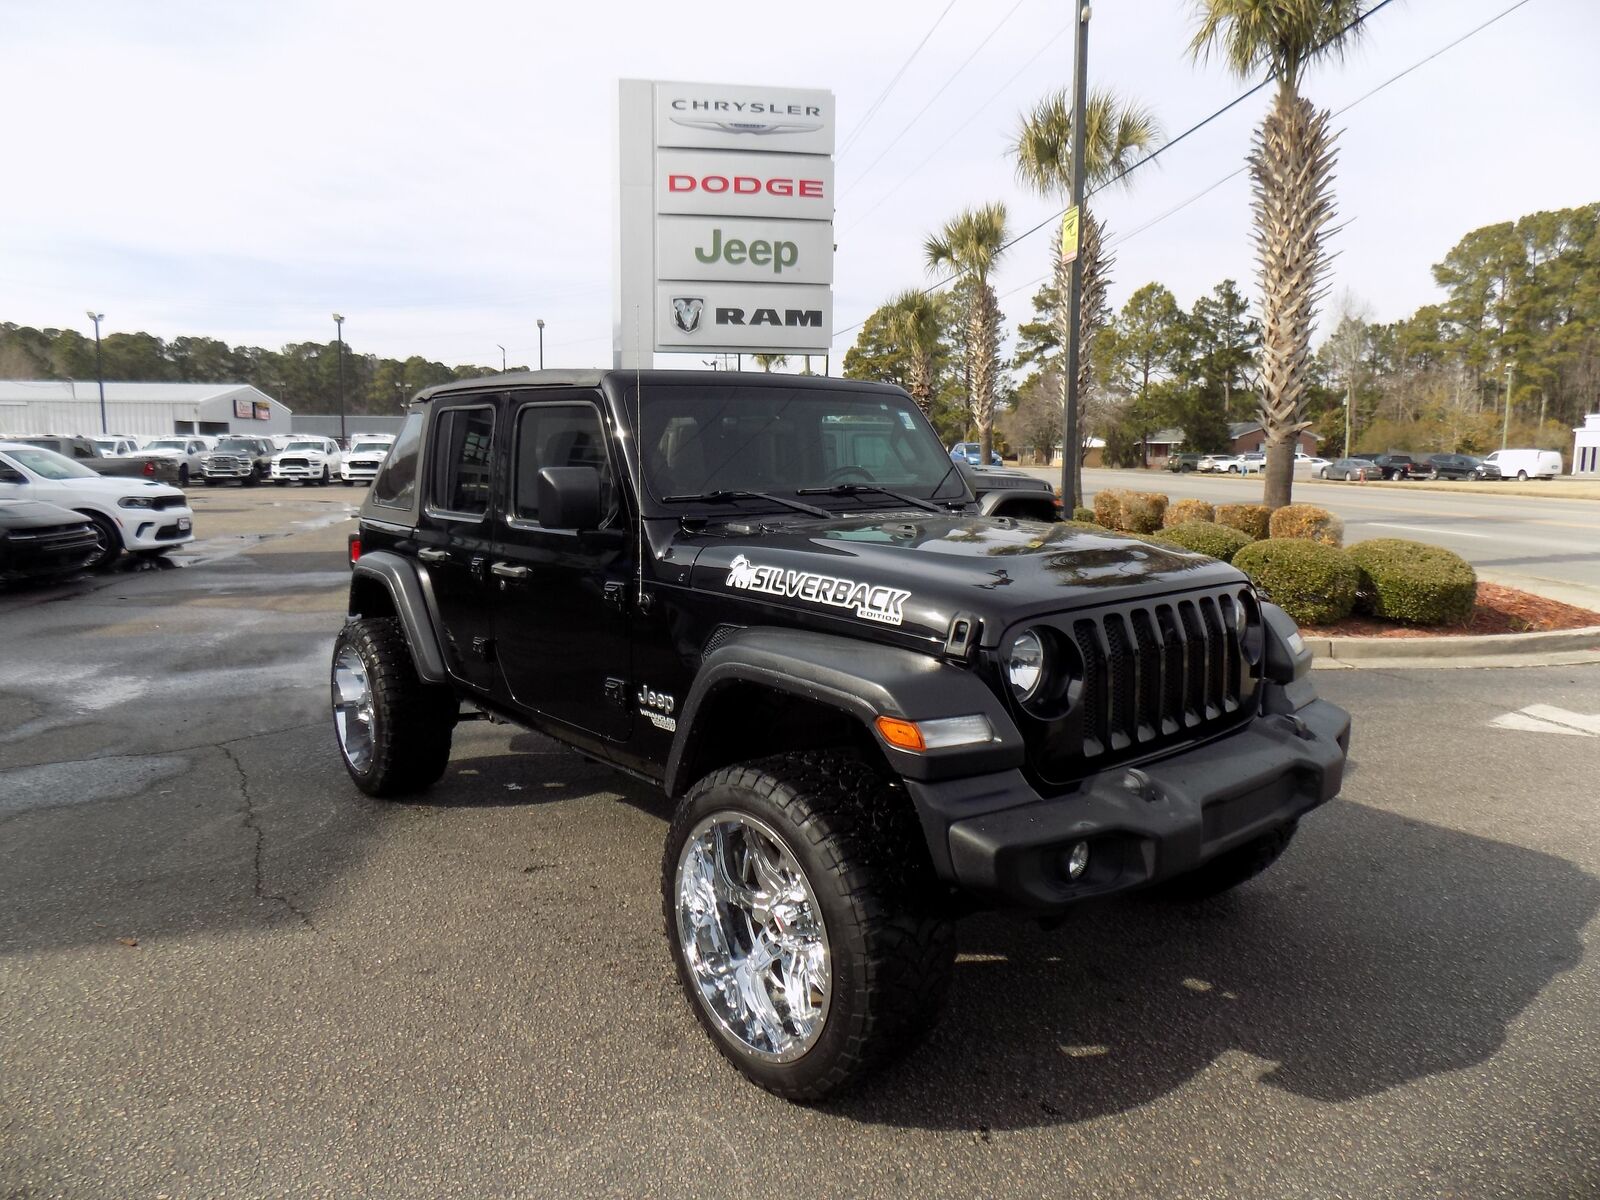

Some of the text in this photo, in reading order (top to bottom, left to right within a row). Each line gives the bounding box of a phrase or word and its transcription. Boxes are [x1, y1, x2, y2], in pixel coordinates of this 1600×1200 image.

[671, 99, 821, 117] CHRYSLER
[668, 175, 824, 198] DODGE
[694, 229, 799, 274] Jeep
[715, 307, 823, 328] RAM
[752, 567, 907, 615] SILVERBACK
[860, 610, 900, 623] EDITION
[638, 684, 675, 715] Jeep
